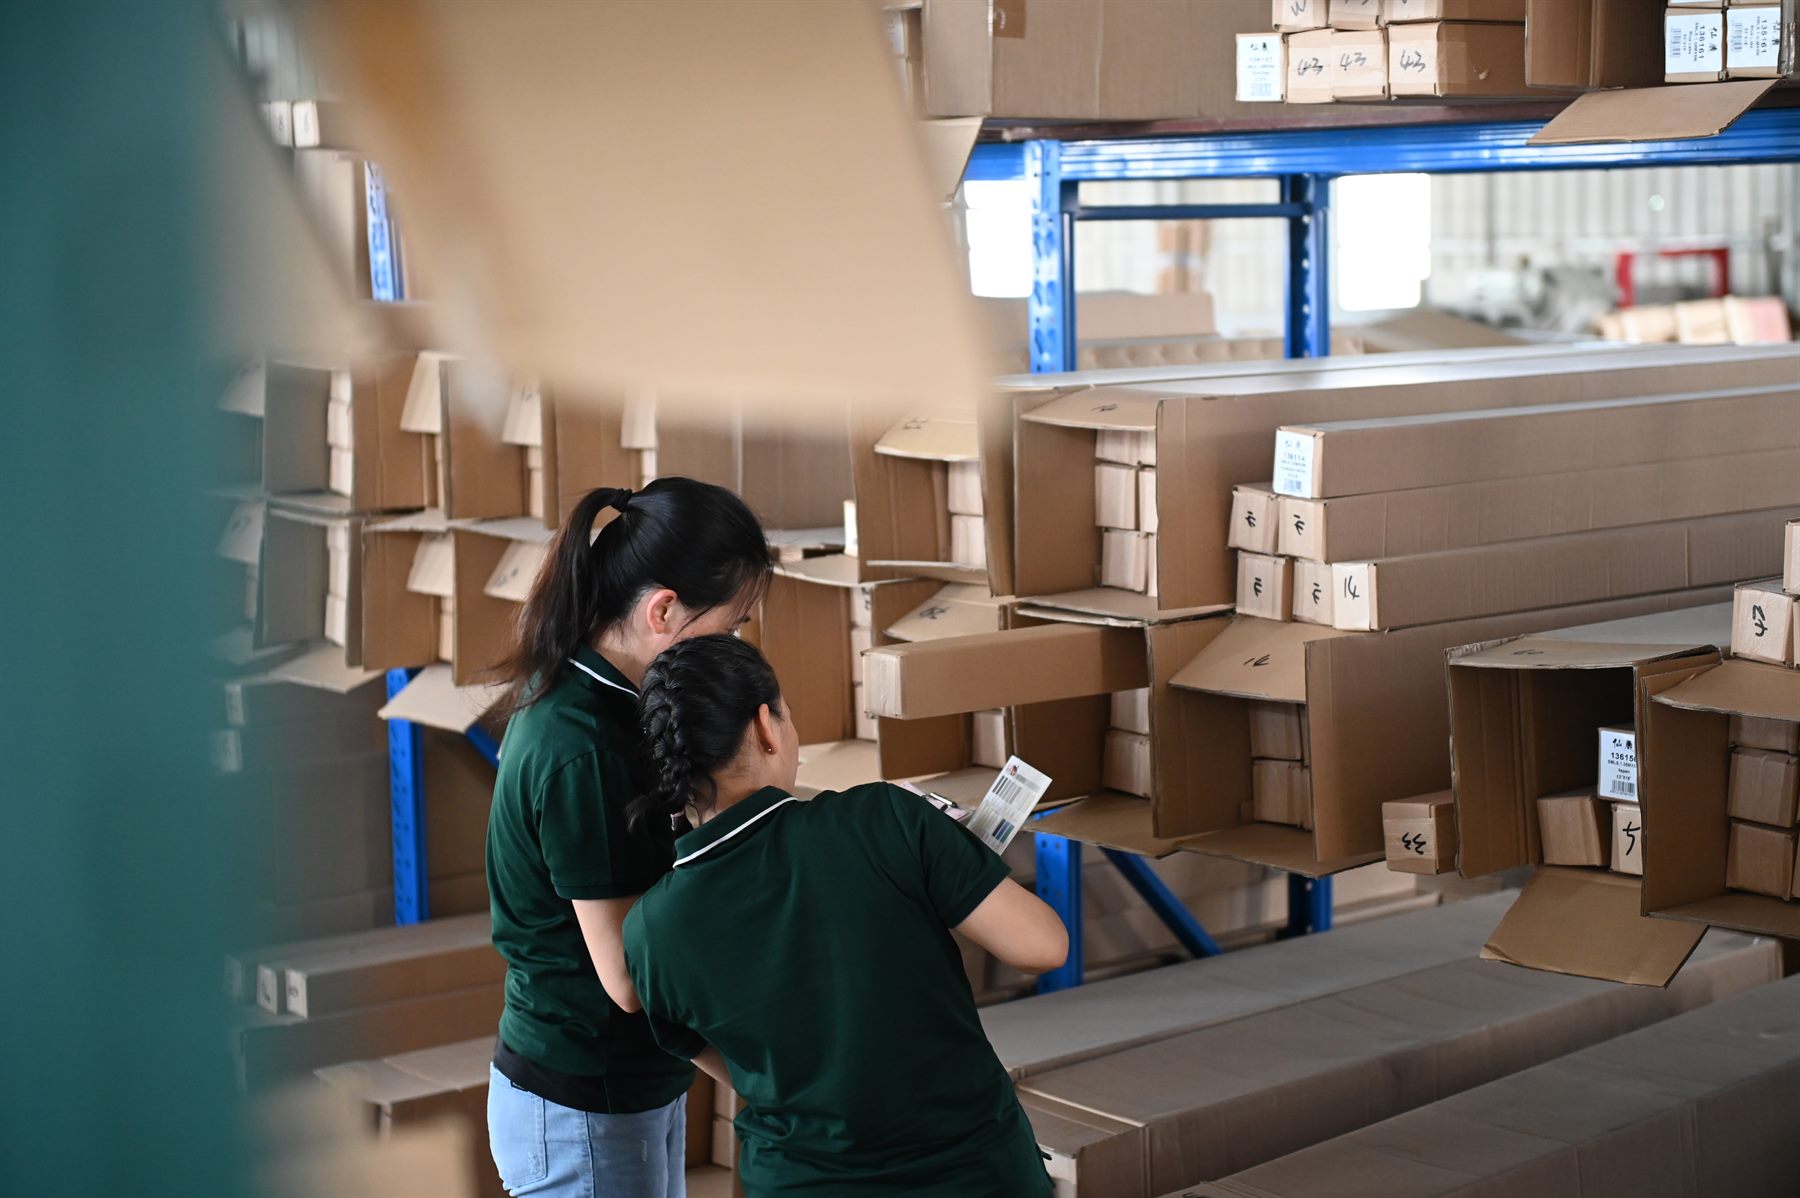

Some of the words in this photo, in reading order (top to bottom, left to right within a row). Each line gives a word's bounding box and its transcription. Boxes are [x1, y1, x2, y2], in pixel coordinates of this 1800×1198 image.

[1340, 52, 1367, 71] 43
[1400, 49, 1426, 72] 43
[1344, 575, 1361, 600] 14
